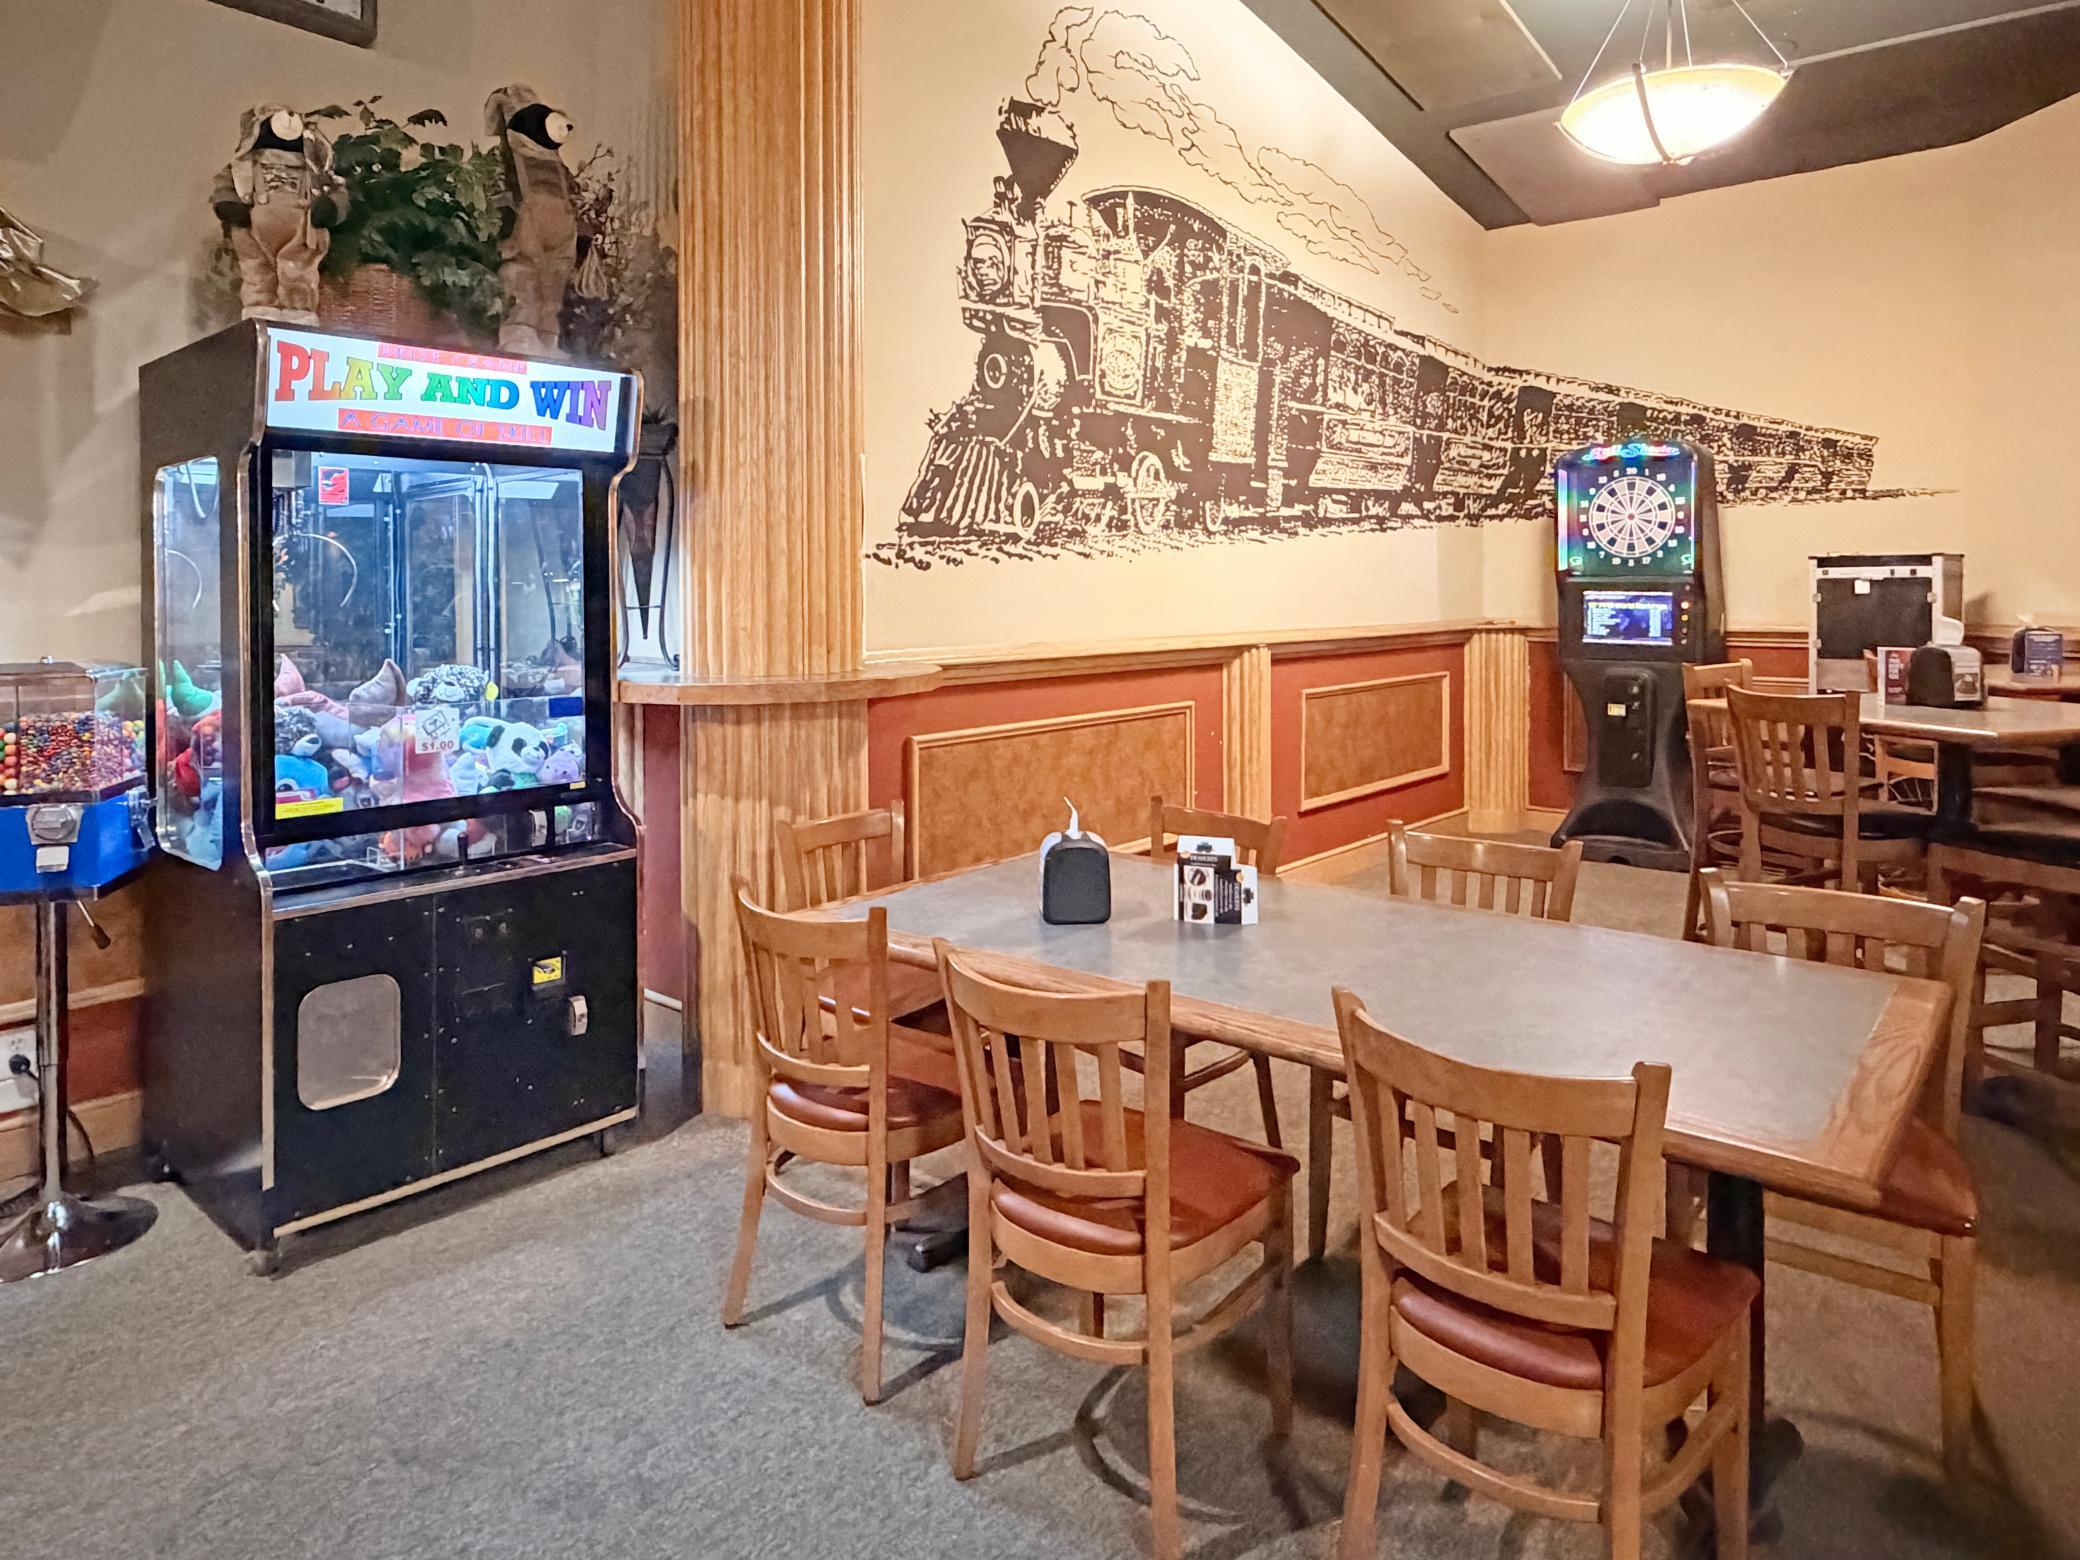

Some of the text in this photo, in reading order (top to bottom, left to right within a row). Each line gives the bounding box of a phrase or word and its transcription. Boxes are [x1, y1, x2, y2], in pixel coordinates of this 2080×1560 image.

[274, 340, 612, 431] PLAY AND WIN
[342, 411, 361, 428] A
[371, 413, 444, 436] GAME
[422, 740, 454, 752] $1.00
